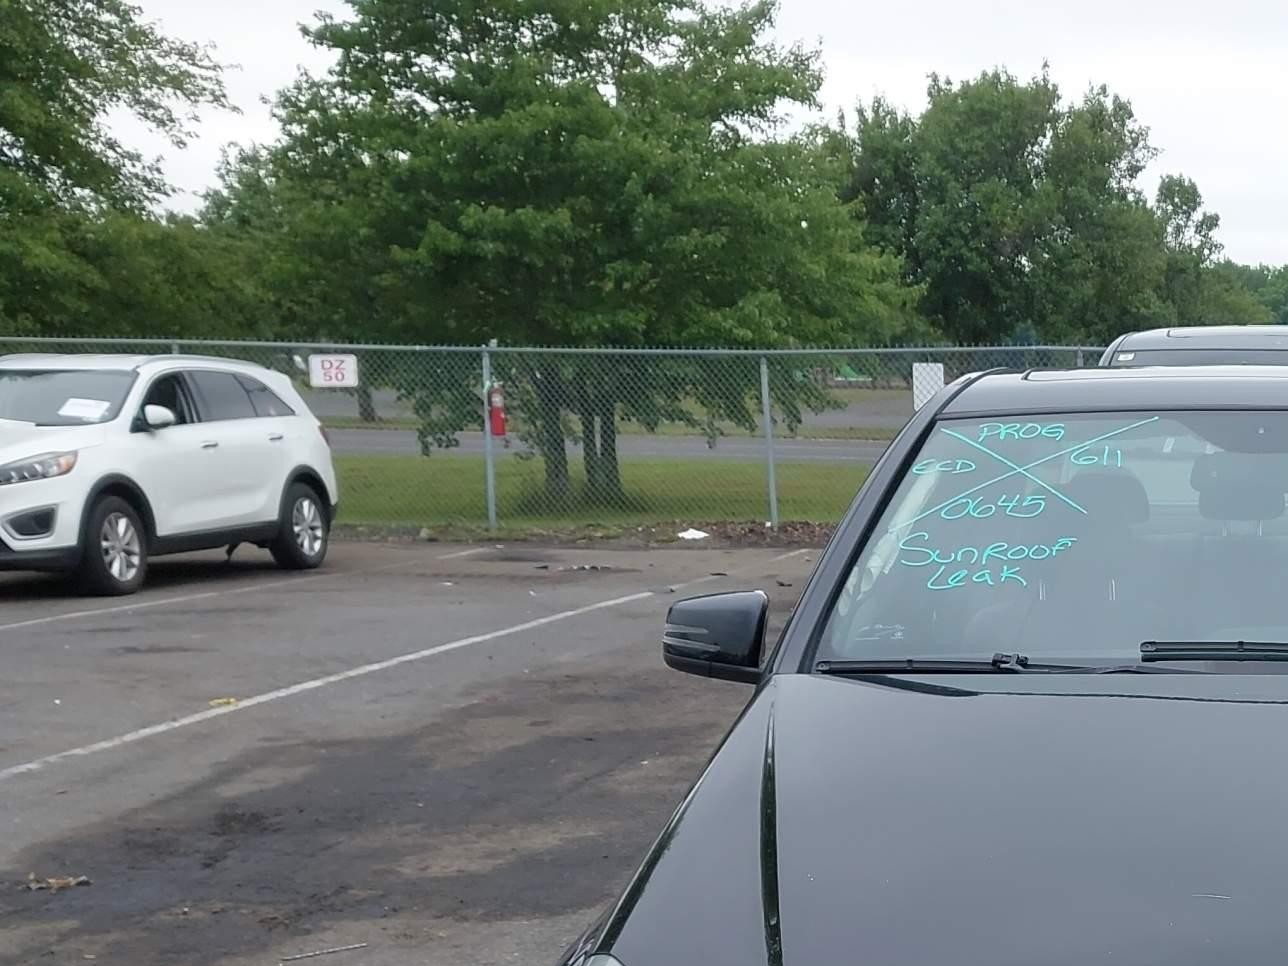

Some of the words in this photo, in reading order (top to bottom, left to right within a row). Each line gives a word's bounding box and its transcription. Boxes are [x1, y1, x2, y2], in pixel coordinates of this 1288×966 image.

[321, 360, 346, 370] DZ
[323, 370, 344, 382] 50
[978, 423, 1065, 441] PROG
[1070, 446, 1121, 467] 611
[940, 495, 1046, 519] 0645
